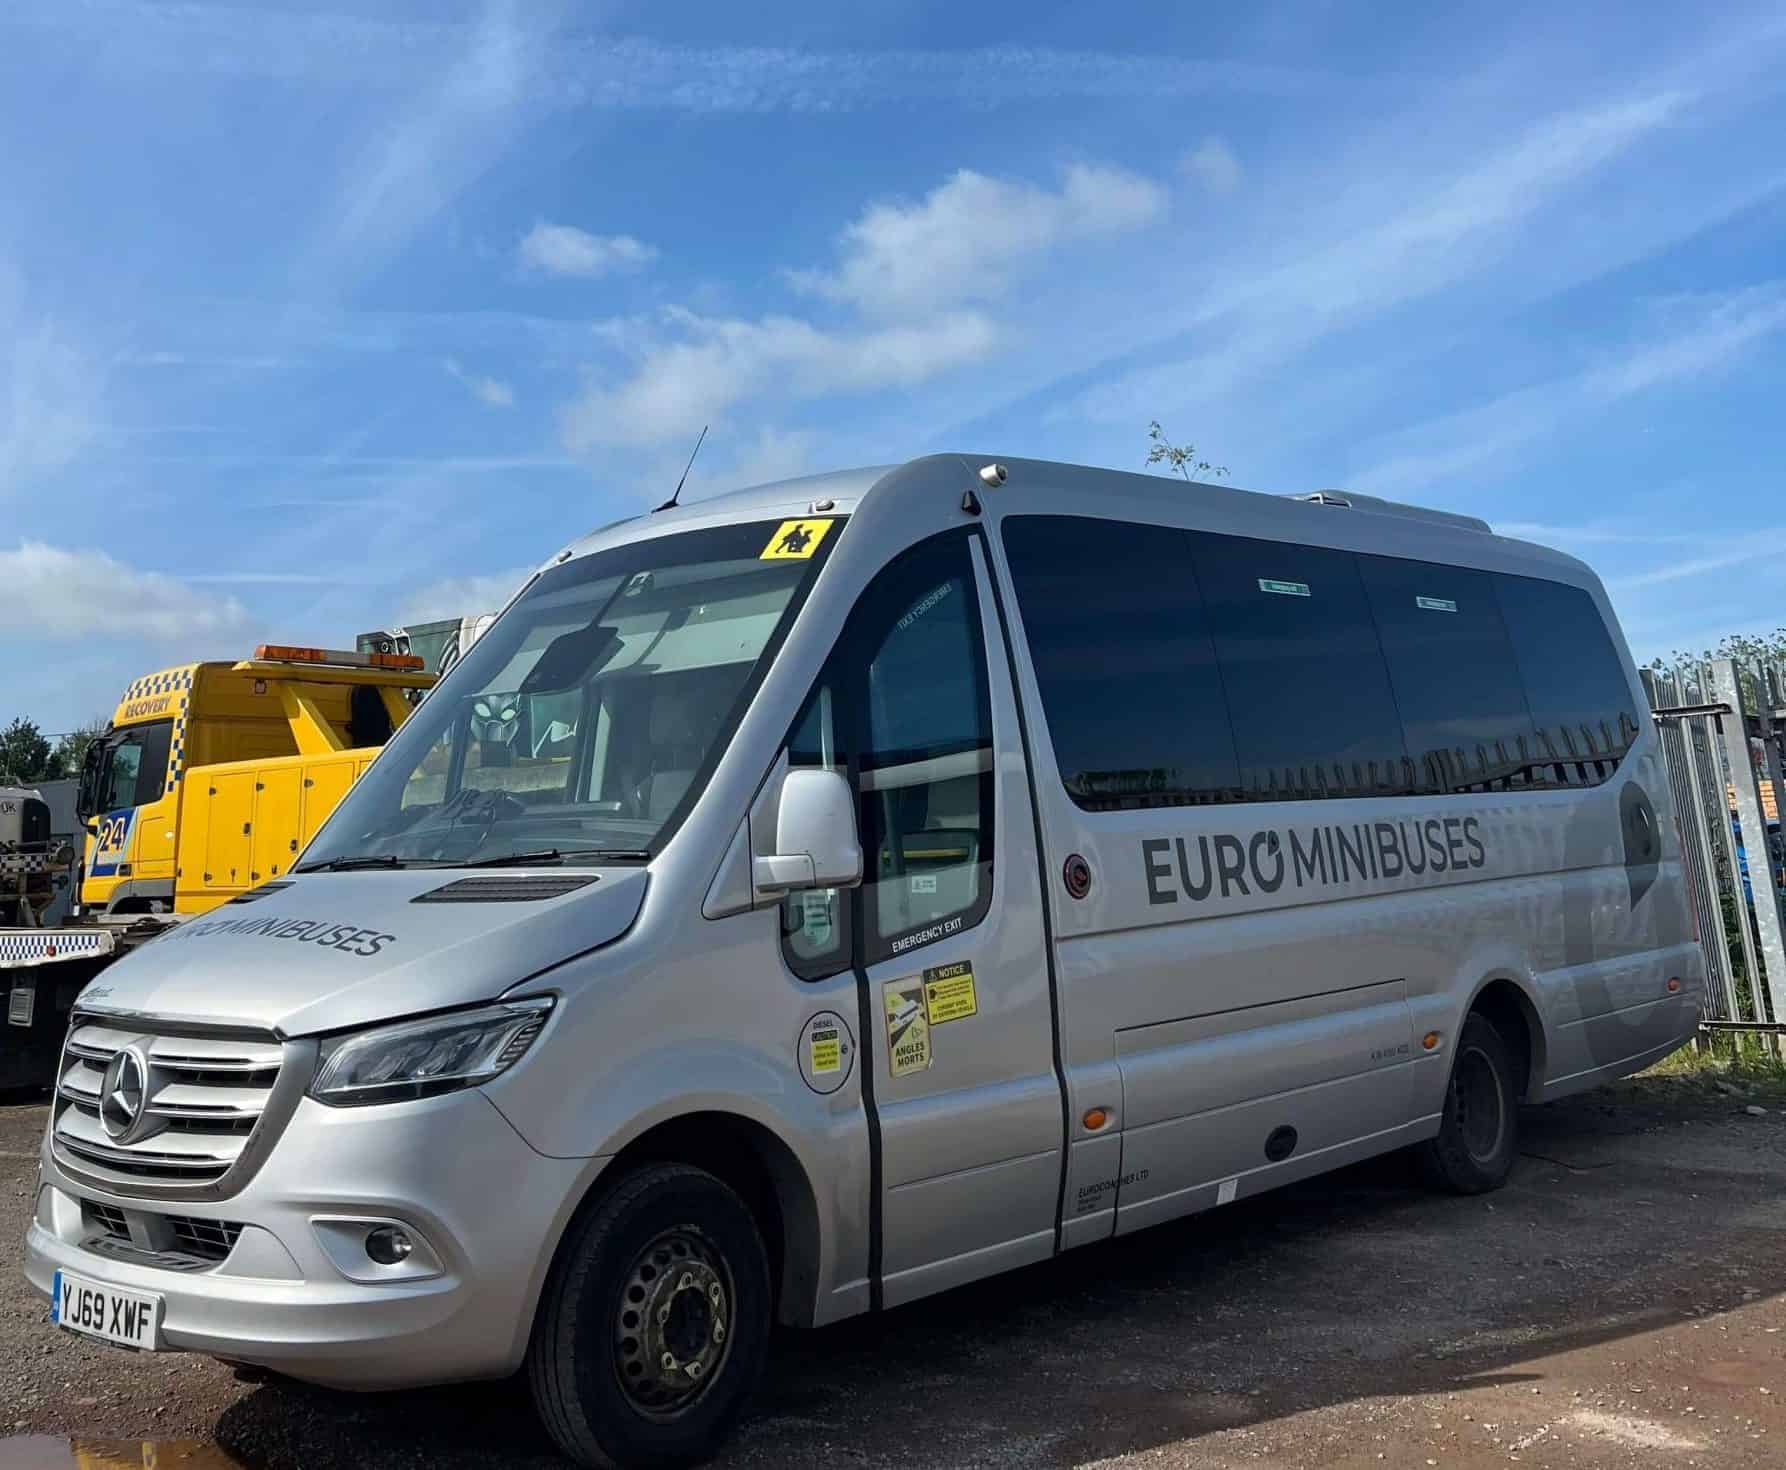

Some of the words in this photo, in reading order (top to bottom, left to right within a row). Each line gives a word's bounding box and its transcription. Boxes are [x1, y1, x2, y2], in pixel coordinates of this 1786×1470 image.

[125, 696, 170, 719] RECOVERY
[98, 818, 124, 852] 24
[891, 924, 944, 953] EMERGENCY
[944, 917, 963, 934] EXIT
[938, 964, 966, 979] NOTICE
[895, 1042, 925, 1057] ANGLES
[897, 1053, 925, 1067] MORTS
[1079, 1173, 1135, 1198] EUROCOAHES
[1135, 1169, 1149, 1181] LTD
[63, 1283, 105, 1327] YJ69
[110, 1295, 152, 1339] XWF
